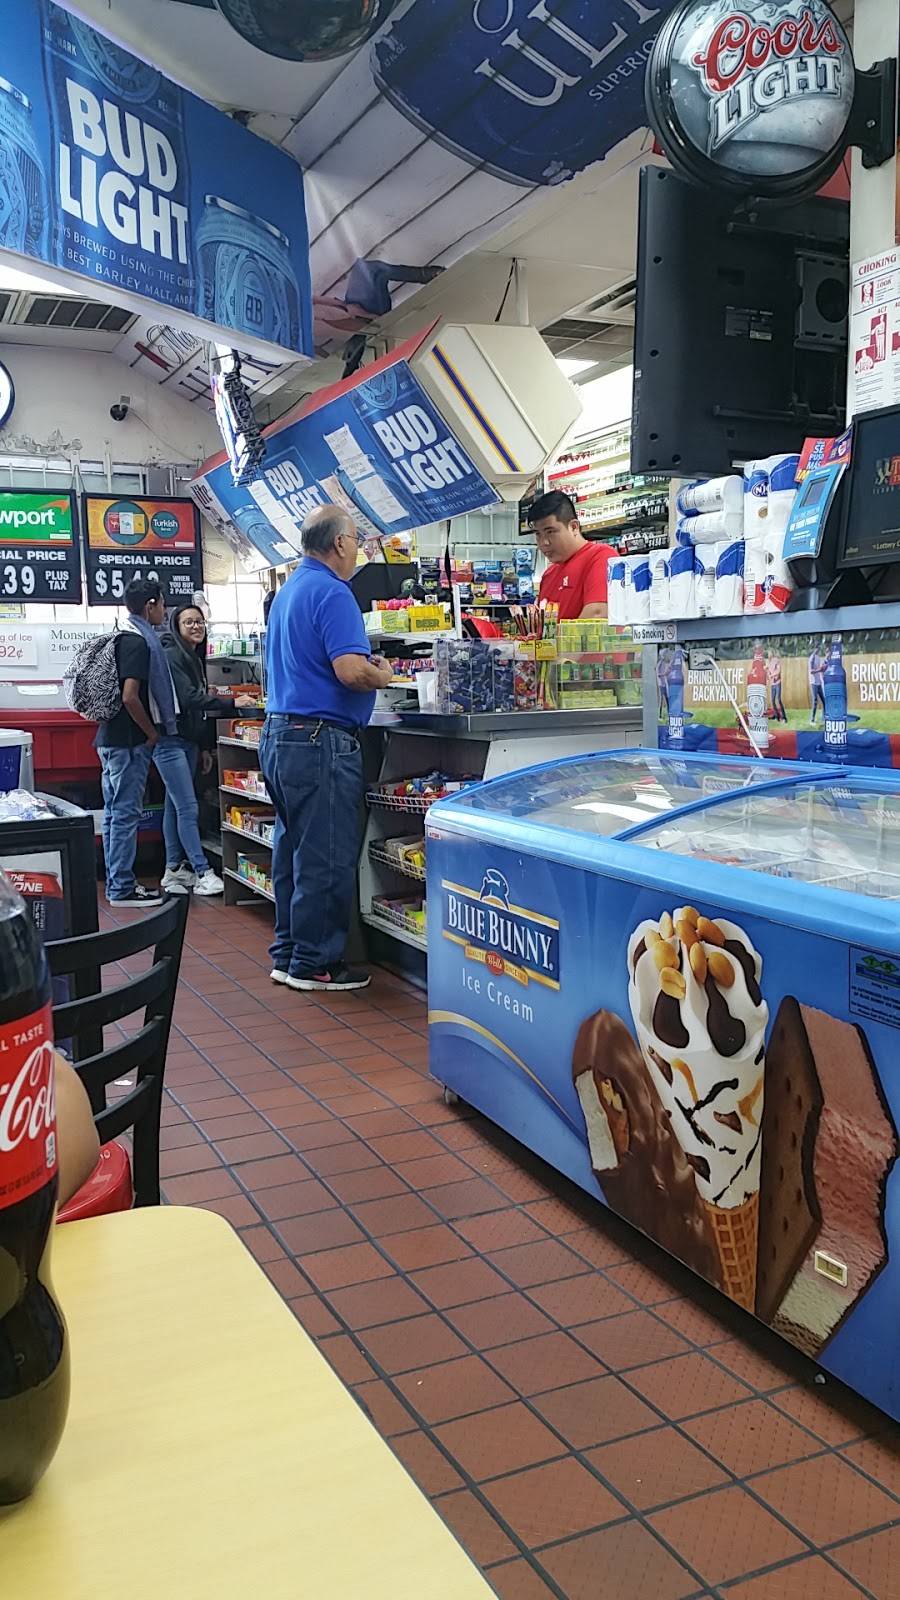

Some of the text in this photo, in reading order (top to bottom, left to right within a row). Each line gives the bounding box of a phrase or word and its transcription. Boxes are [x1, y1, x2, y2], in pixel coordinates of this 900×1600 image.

[692, 9, 843, 93] Coors
[588, 33, 660, 101] SUPERIO
[712, 54, 842, 149] LIGHT
[65, 77, 178, 194] BUD
[59, 141, 189, 265] LIGHT
[73, 231, 117, 260] BREWED
[157, 269, 175, 284] THE
[858, 253, 897, 276] CHOKING
[67, 247, 91, 269] BEST
[95, 262, 140, 290] BARLEY
[373, 404, 438, 459] BUD
[391, 437, 473, 494] LIGHT
[264, 460, 304, 497] BUD
[153, 518, 179, 528] Turkish
[0, 551, 67, 561] IAL PRICE
[98, 555, 191, 566] SPECIAL PRICE
[45, 570, 70, 581] PLUS
[48, 580, 68, 591] TAX
[8, 633, 17, 641] of
[19, 633, 33, 642] Ice
[51, 629, 97, 640] Monster
[633, 628, 665, 640] No Smoking
[51, 643, 57, 652] 2
[58, 643, 70, 652] for
[687, 669, 712, 684] BRING
[728, 667, 744, 684] THE
[852, 662, 887, 682] BRING
[692, 685, 738, 701] BACKYARD
[669, 717, 683, 726] BUD
[825, 720, 846, 732] BUD
[824, 732, 848, 744] LIGHT
[10, 873, 25, 882] THE
[14, 881, 43, 893] ONE
[447, 894, 486, 942] BLUE
[462, 967, 534, 1023] Ice Cream
[14, 1023, 45, 1046] TASTE
